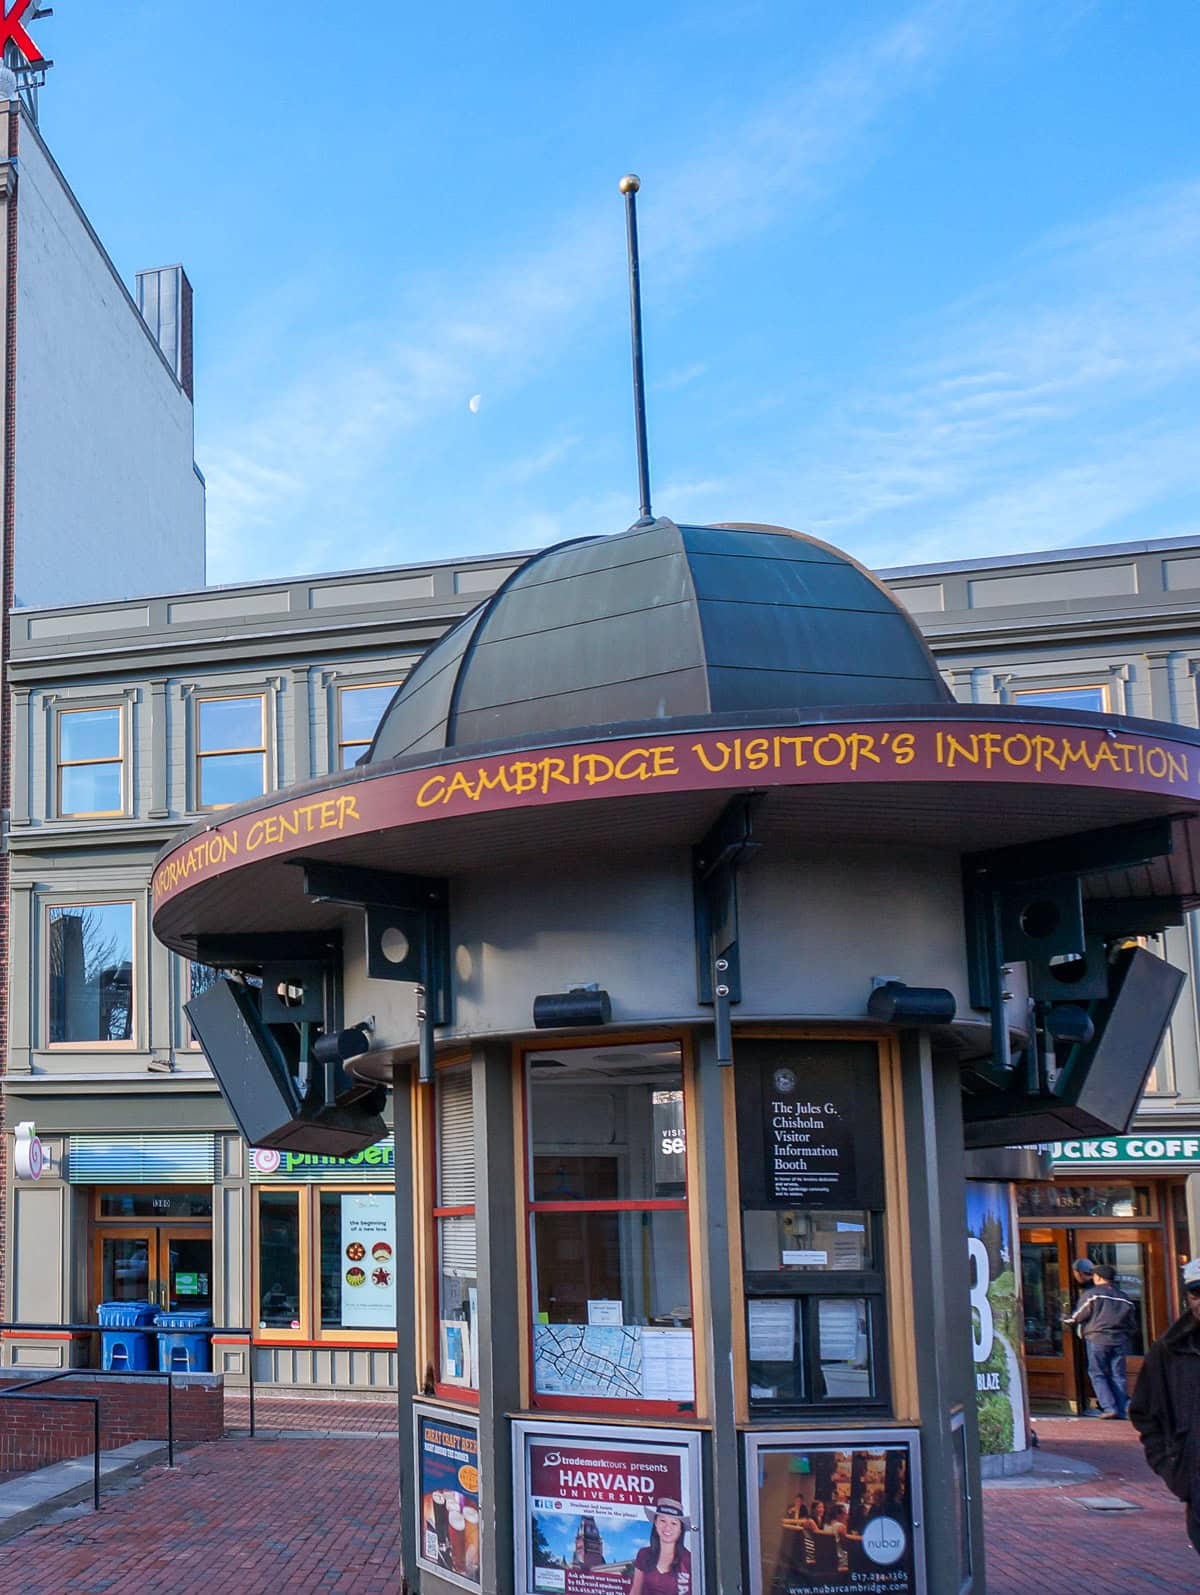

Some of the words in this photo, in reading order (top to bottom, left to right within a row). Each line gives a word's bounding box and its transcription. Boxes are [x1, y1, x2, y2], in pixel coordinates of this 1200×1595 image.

[416, 746, 680, 807] CAMBRIDGE
[691, 732, 916, 772] VISITOR'S
[936, 731, 1189, 783] INFORMATION
[154, 831, 239, 899] NFORMATION
[246, 795, 360, 851] CENTER
[772, 1101, 793, 1113] The
[795, 1102, 821, 1115] Jules
[824, 1102, 838, 1115] G.
[772, 1116, 824, 1129] Chisholm
[774, 1130, 811, 1142] Visitor
[662, 1138, 686, 1155] se
[774, 1144, 839, 1156] Information
[774, 1158, 808, 1170] Booth
[976, 1373, 1000, 1391] BLAZE
[561, 1456, 627, 1470] trademarktours
[630, 1463, 668, 1473] presents
[559, 1470, 655, 1493] HARVARD
[559, 1489, 657, 1504] UNIVERSITY
